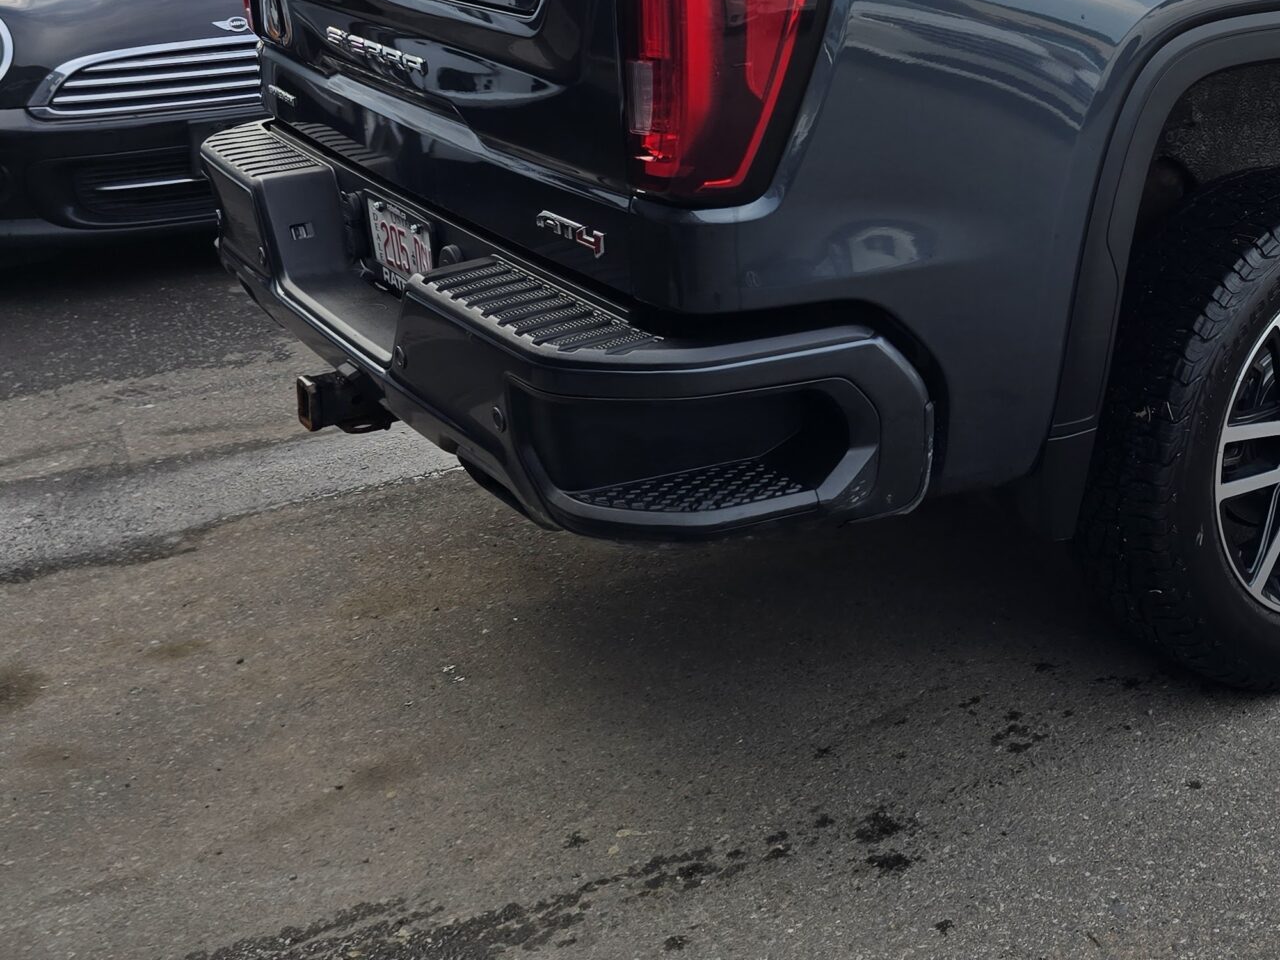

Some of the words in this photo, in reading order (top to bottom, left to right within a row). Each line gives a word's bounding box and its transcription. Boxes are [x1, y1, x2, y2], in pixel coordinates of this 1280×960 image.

[325, 25, 429, 76] SIERRA
[380, 220, 411, 275] 205
[536, 210, 605, 258] AT4
